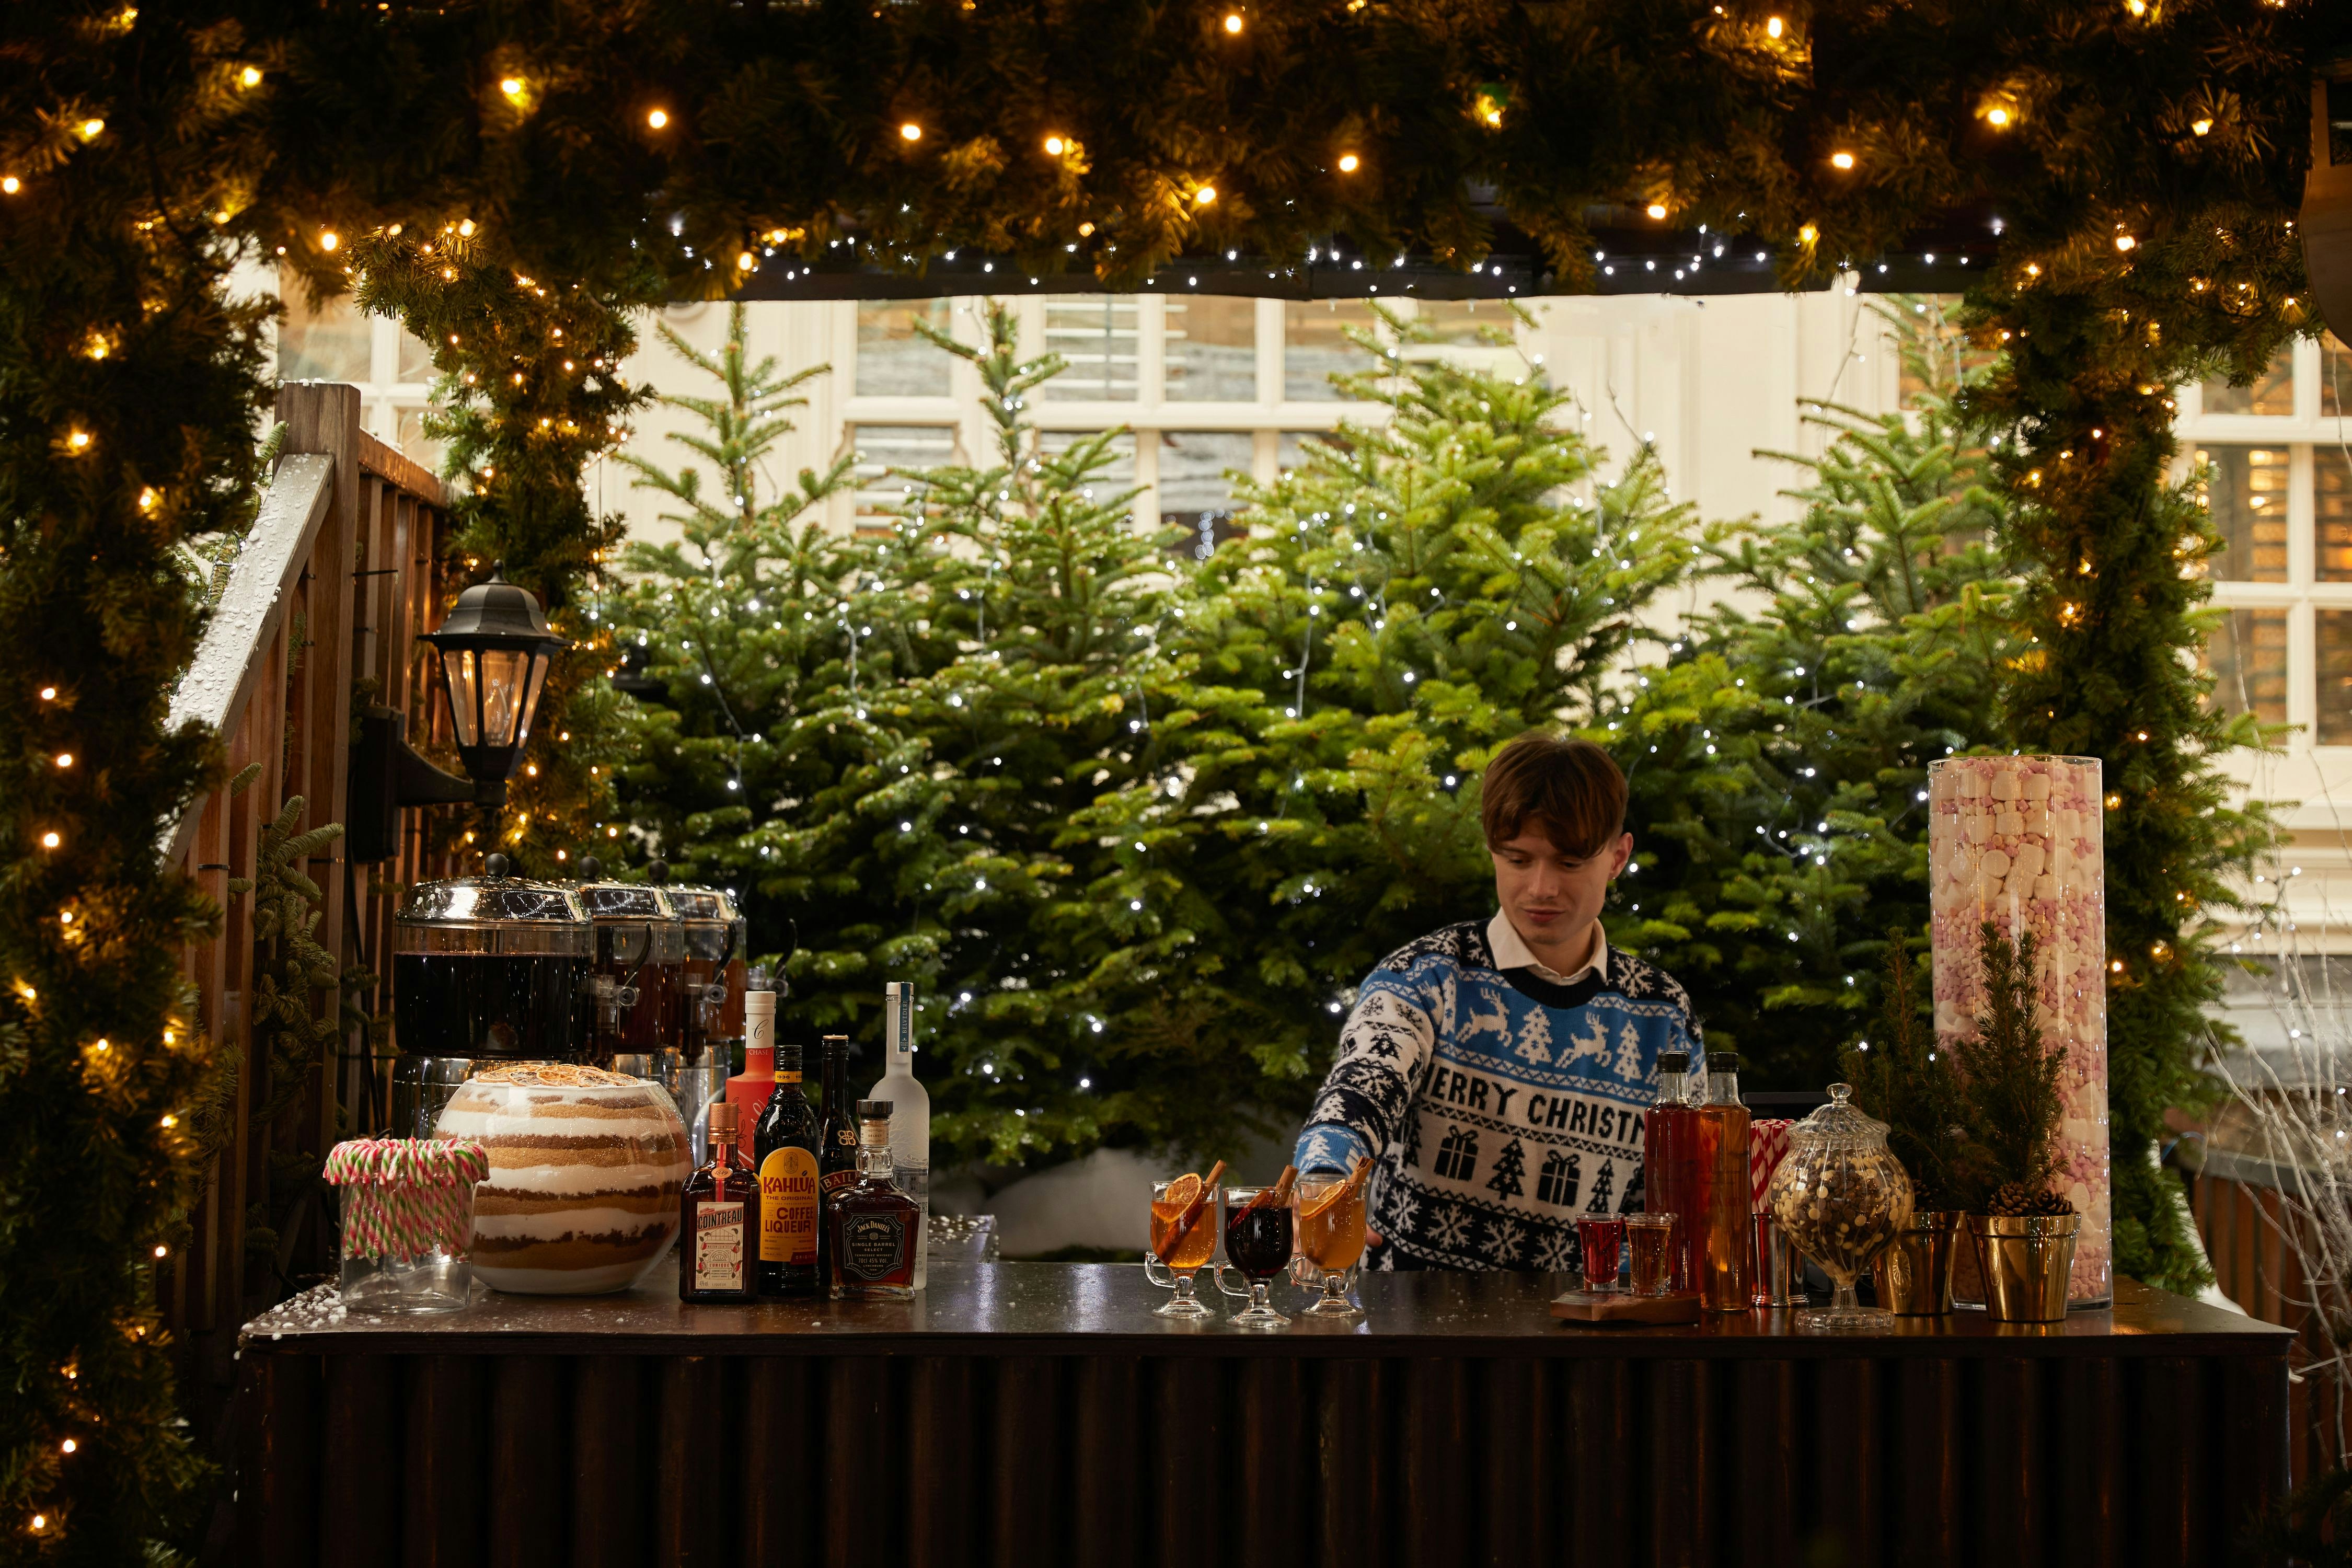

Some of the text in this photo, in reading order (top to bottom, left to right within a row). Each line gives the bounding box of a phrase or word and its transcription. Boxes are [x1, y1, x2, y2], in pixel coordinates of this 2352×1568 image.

[698, 1208, 742, 1229] COINTREAU
[777, 1206, 813, 1220] COFFEE
[765, 1219, 811, 1233] LIQUEUR
[857, 1220, 891, 1233] JACK DANIEL'S
